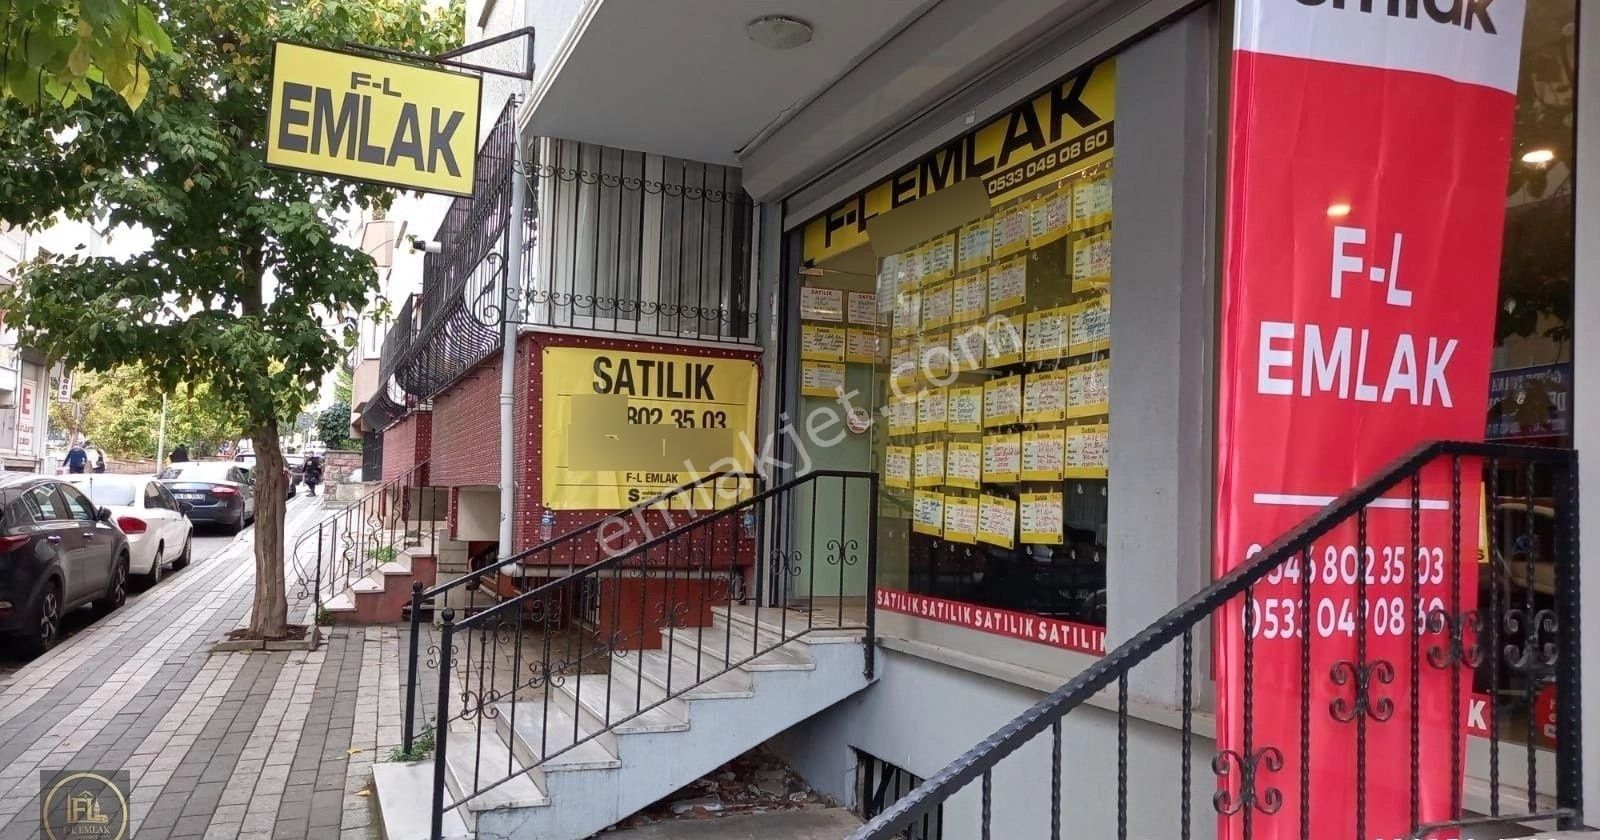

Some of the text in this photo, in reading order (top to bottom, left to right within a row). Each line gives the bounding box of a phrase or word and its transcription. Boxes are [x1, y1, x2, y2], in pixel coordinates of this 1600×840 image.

[351, 71, 402, 98] F-L
[277, 80, 466, 178] EMLAK
[890, 63, 1103, 209] EMLAK
[988, 129, 1108, 195] 0533 049 08 60
[1330, 225, 1413, 307] F-L
[592, 356, 715, 401] SATILIK
[1257, 320, 1459, 408] EMLAK
[671, 409, 695, 429] 35
[626, 472, 679, 484] F-L EMLAK
[1322, 544, 1375, 585] 802
[1380, 545, 1405, 585] 35
[1418, 546, 1444, 585] 03
[877, 590, 920, 614] SATILIK
[921, 600, 972, 625] SATILIK
[975, 612, 1034, 637] SATILIK
[1241, 597, 1304, 640] 053
[1317, 597, 1370, 637] 04
[1374, 597, 1406, 636] 08
